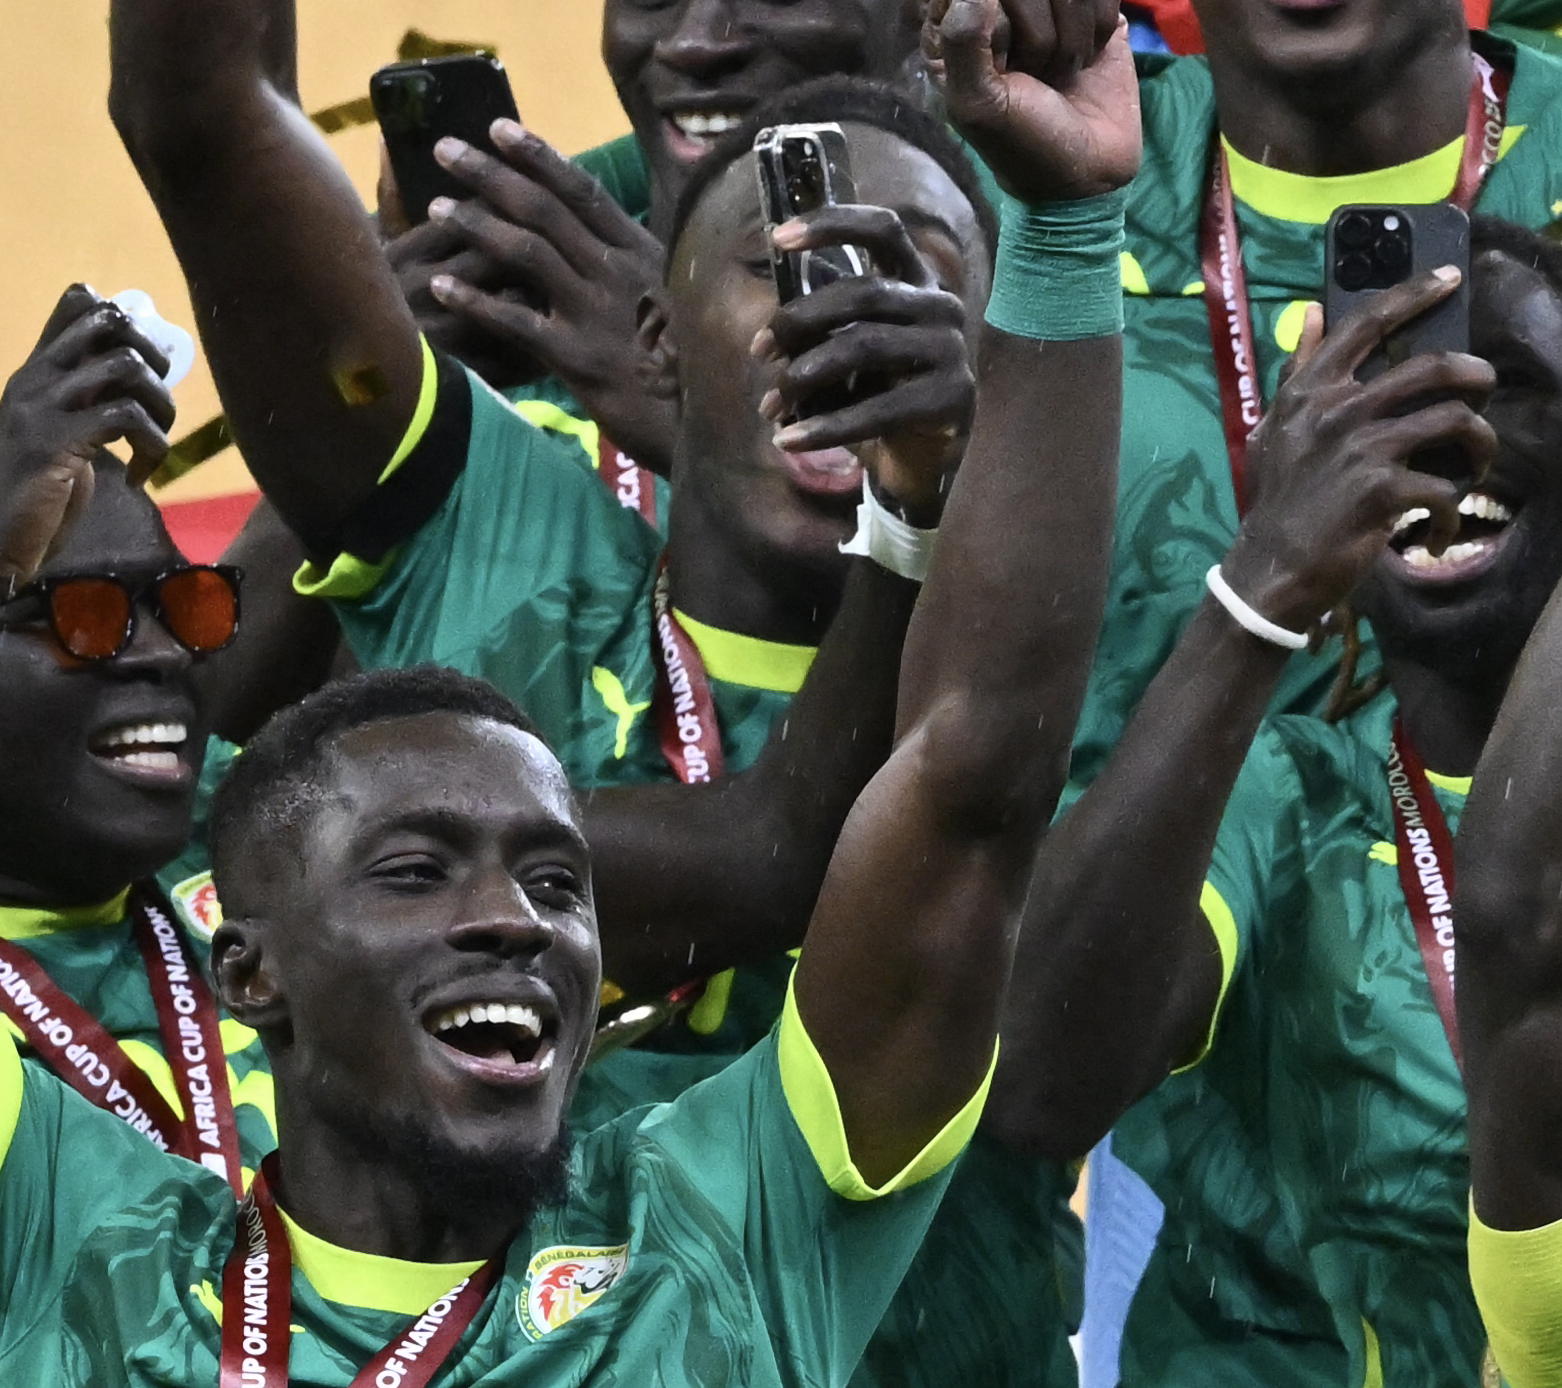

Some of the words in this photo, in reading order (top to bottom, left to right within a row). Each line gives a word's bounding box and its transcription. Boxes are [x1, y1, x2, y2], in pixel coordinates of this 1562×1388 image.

[677, 713, 703, 744] OF
[1406, 827, 1452, 915] NATIONS
[170, 982, 197, 1016] OF
[38, 1017, 73, 1048] OF
[179, 1021, 207, 1063] CUP
[65, 1043, 111, 1088] CUP
[187, 1064, 221, 1148] AFRICA
[242, 1322, 268, 1357] OF
